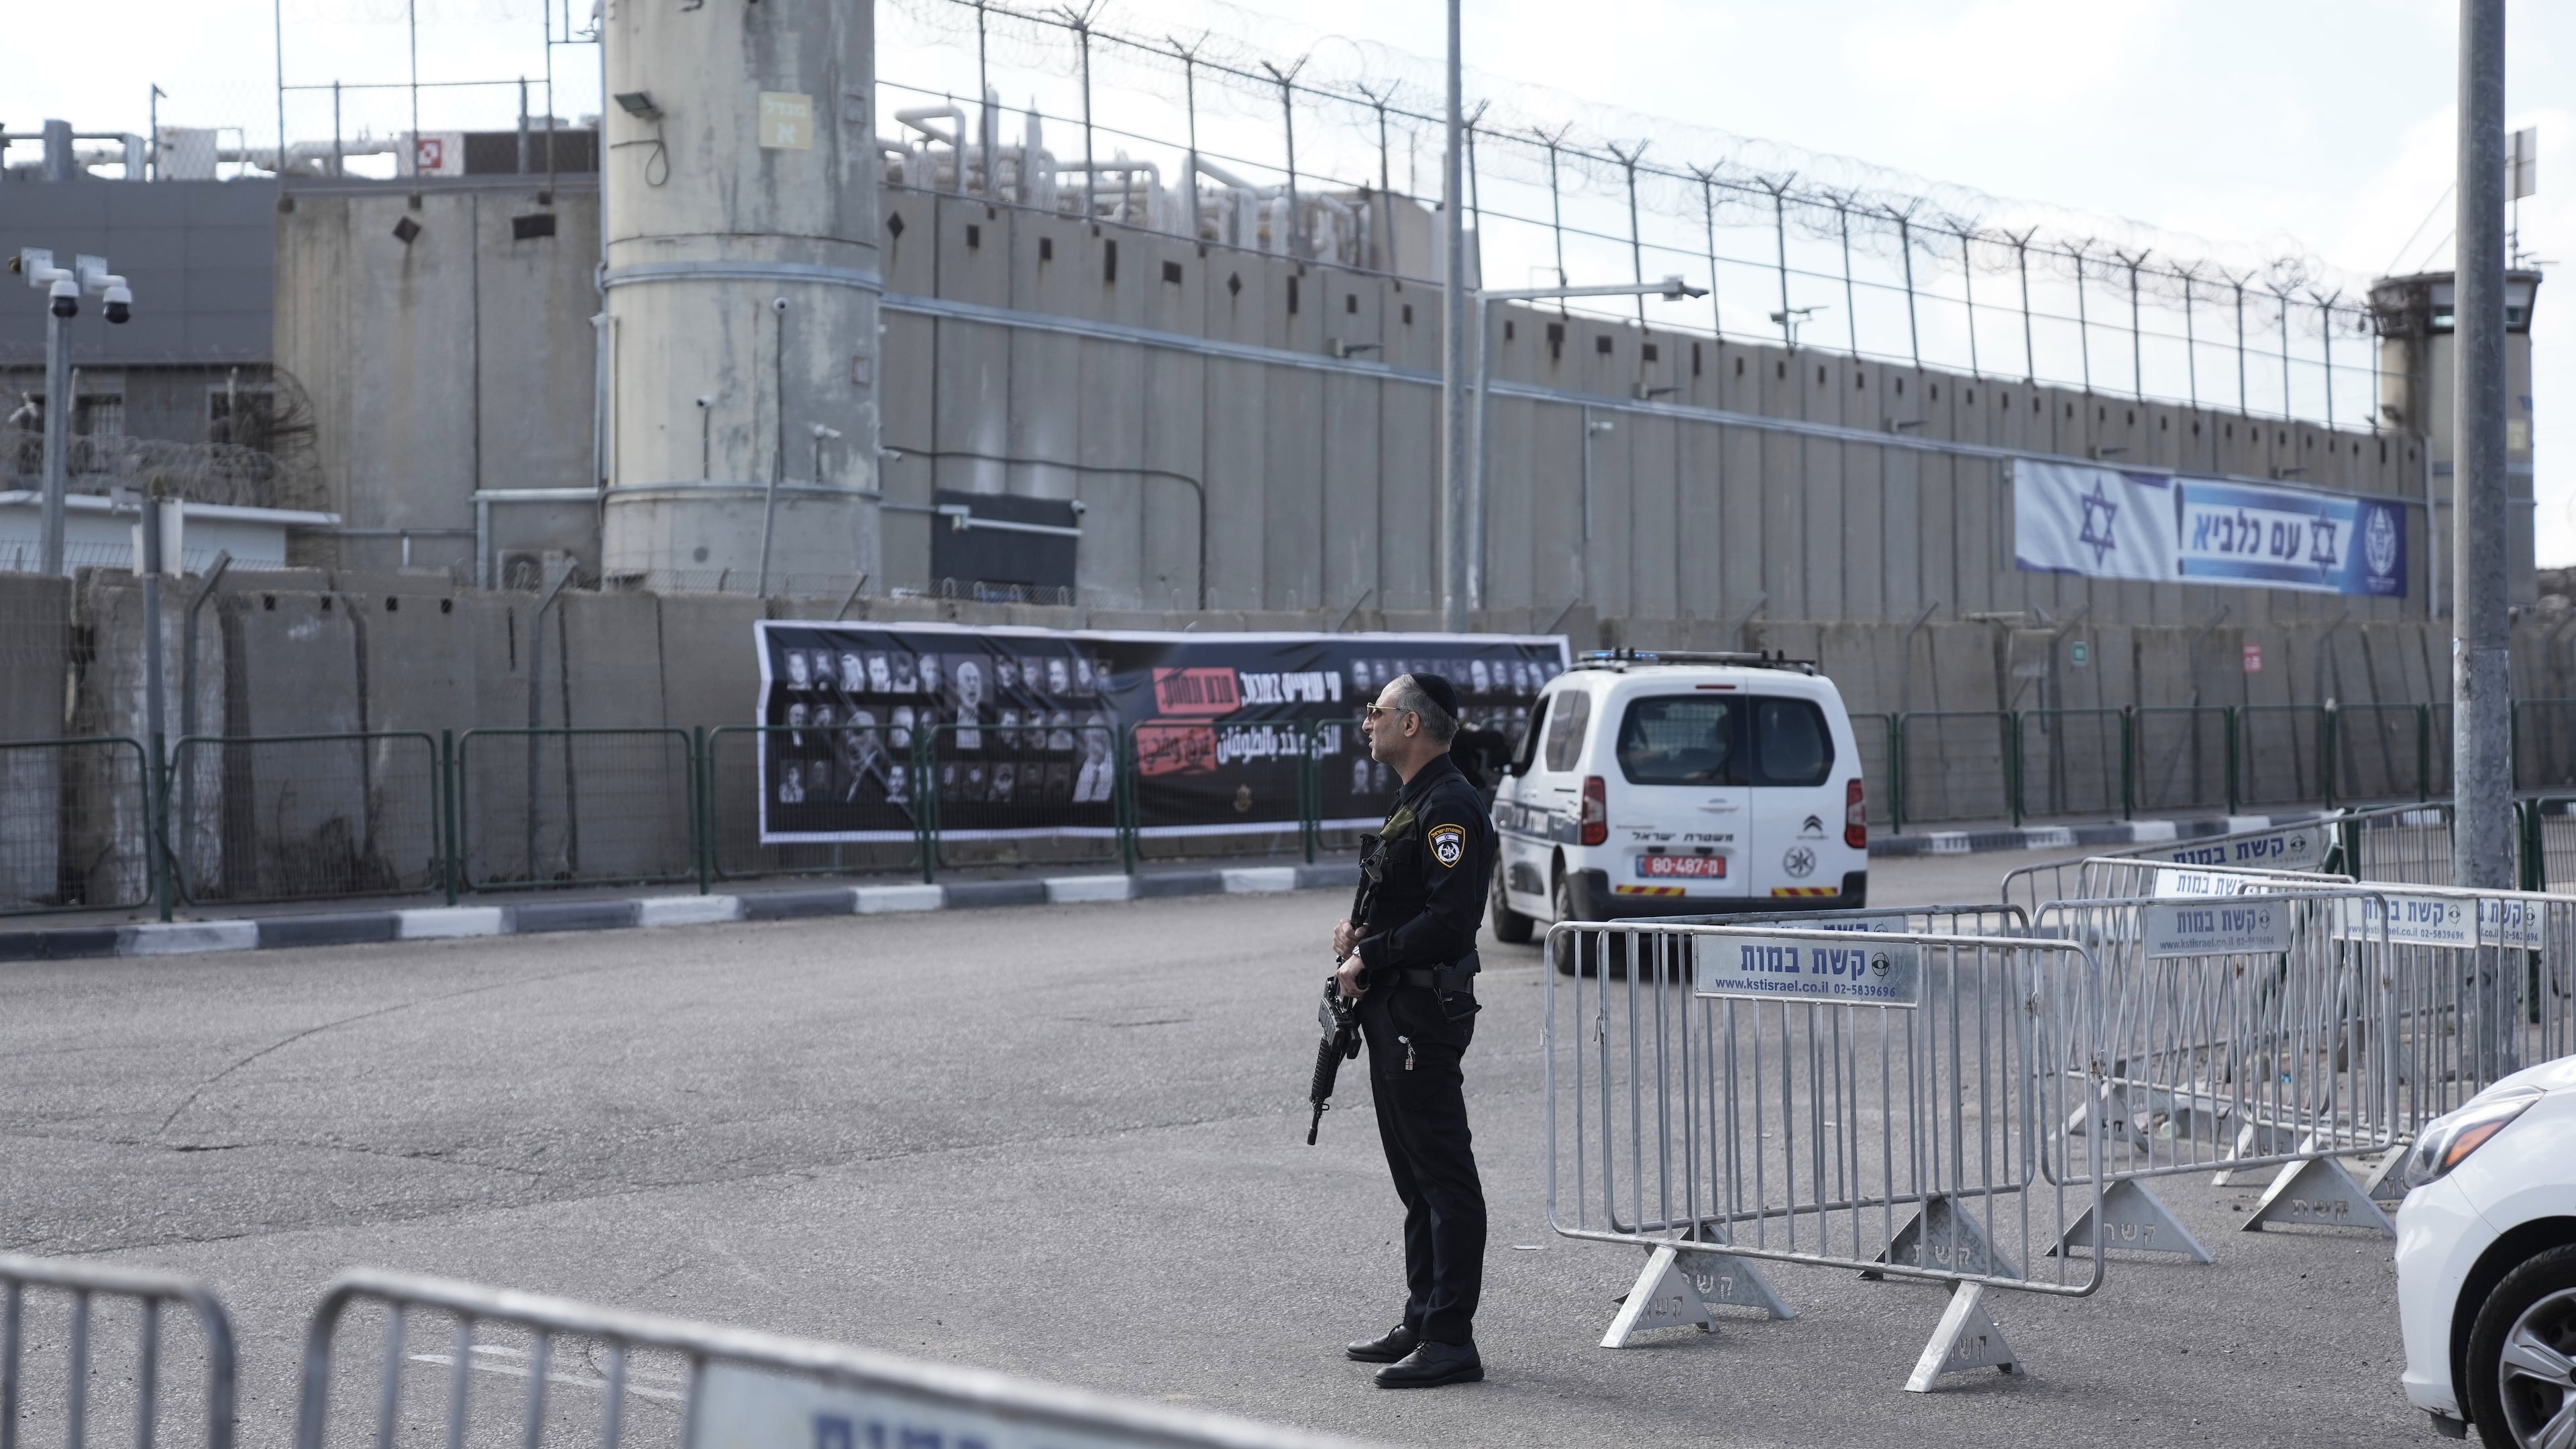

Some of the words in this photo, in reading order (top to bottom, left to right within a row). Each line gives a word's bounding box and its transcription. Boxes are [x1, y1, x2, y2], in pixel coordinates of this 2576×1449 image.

[2192, 508, 2261, 554] כלביא
[2270, 520, 2301, 560] עם
[1631, 831, 1676, 841] ישראל
[1683, 833, 1734, 842] משטרת
[2236, 837, 2284, 859] קשת
[2176, 874, 2210, 894] במות
[2215, 877, 2245, 895] שת
[2177, 910, 2214, 933] במות
[2222, 909, 2256, 934] קשת
[2364, 899, 2400, 922] בות
[2407, 902, 2445, 927] קשת
[2420, 929, 2464, 939] 02-5839696
[1741, 945, 1800, 973] במות
[1812, 948, 1865, 981] קשת
[1715, 977, 1829, 994] www.kstisrael.co.il
[1834, 984, 1896, 998] 02-5839696
[2292, 1198, 2349, 1222] קשת
[1682, 1273, 1733, 1299] קש
